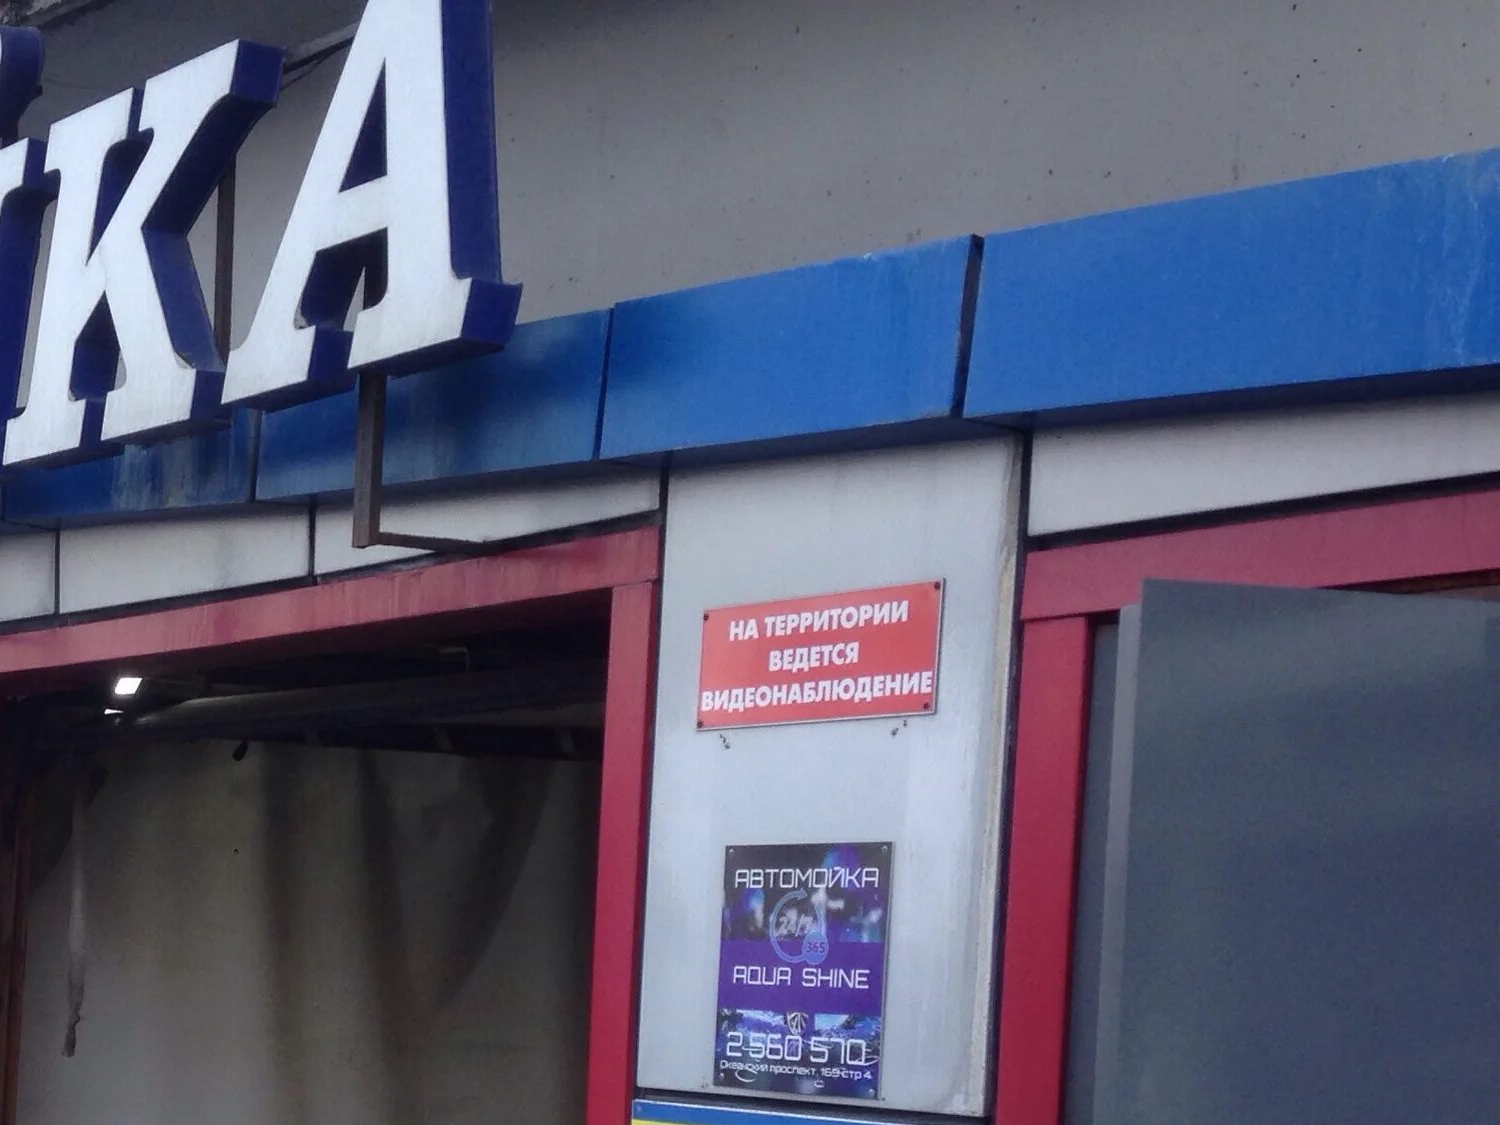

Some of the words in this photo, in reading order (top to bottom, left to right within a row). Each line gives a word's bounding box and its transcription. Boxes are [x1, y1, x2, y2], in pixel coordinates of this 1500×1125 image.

[729, 616, 759, 642] НА
[764, 601, 910, 638] ТЕРРИТОРИИ
[768, 641, 861, 674] ВЕДЕТСЯ
[700, 671, 933, 713] ВИДЕОНАБЛЮДЕНИЕ
[734, 866, 880, 890] АВТОМОЙКА
[732, 966, 792, 986] AQUA
[801, 967, 871, 989] SHINE
